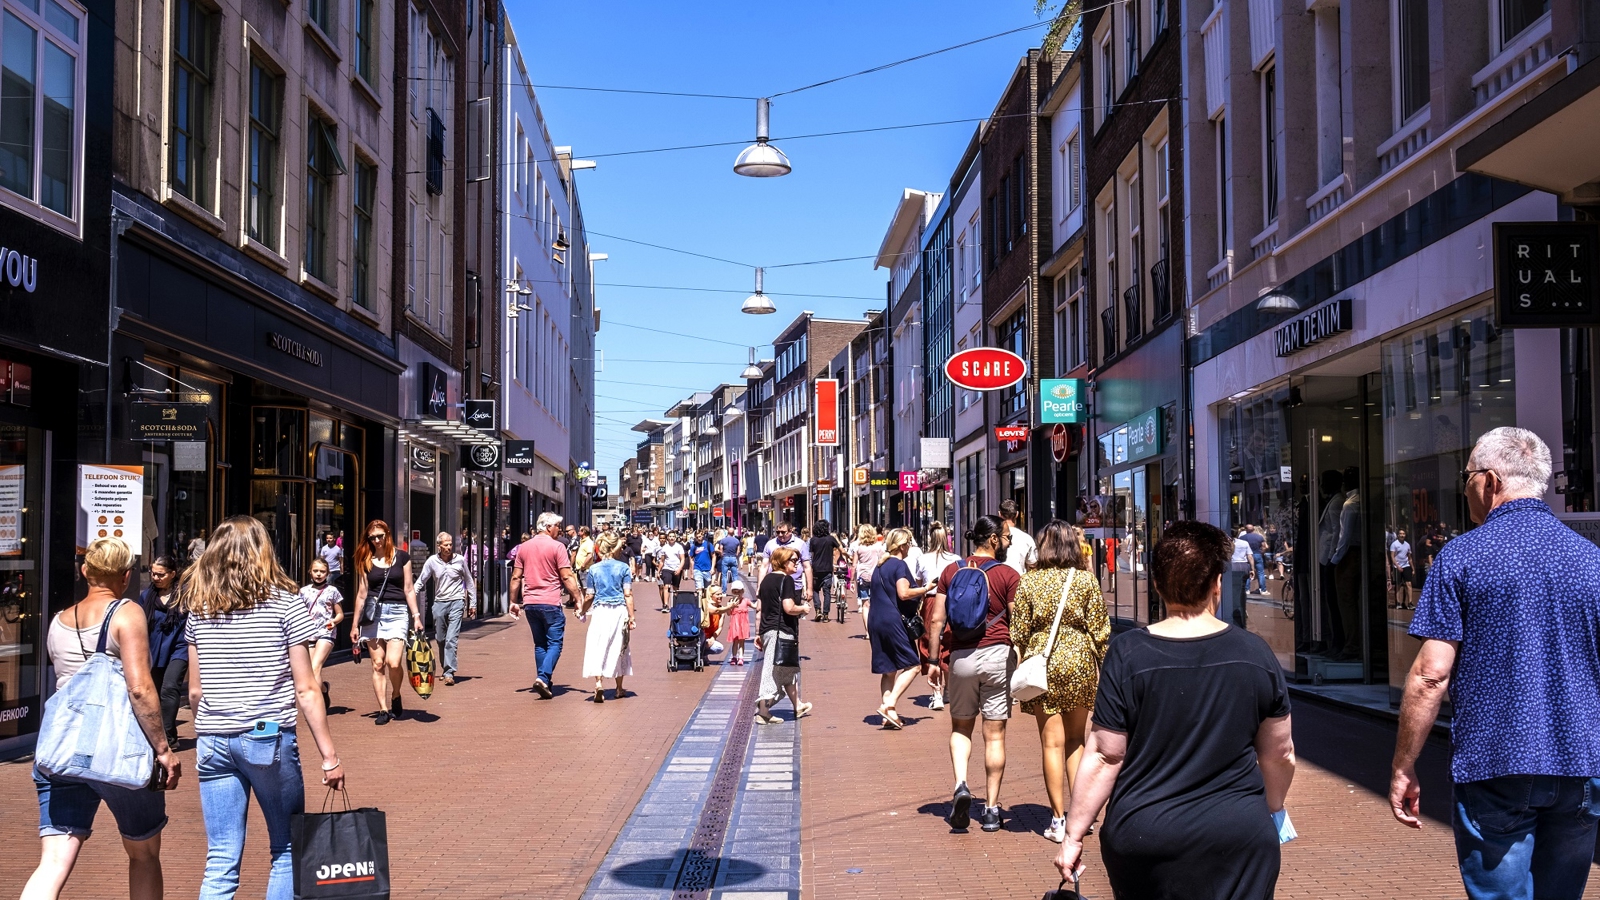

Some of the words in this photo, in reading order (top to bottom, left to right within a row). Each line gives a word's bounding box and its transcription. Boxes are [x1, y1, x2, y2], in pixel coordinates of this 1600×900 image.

[0, 246, 37, 293] YOU
[1274, 320, 1300, 357] WAM
[1303, 300, 1341, 344] DENIM
[272, 331, 323, 367] SCOTCH&SODA
[962, 361, 1010, 377] SCORE
[1044, 400, 1083, 412] Pearle
[468, 409, 492, 422] Lovisa
[819, 429, 836, 440] PERRY
[1128, 422, 1144, 447] Pearle
[858, 471, 865, 480] B
[870, 477, 898, 486] sacha
[592, 487, 607, 498] JD
[0, 706, 29, 723] VERKOOP
